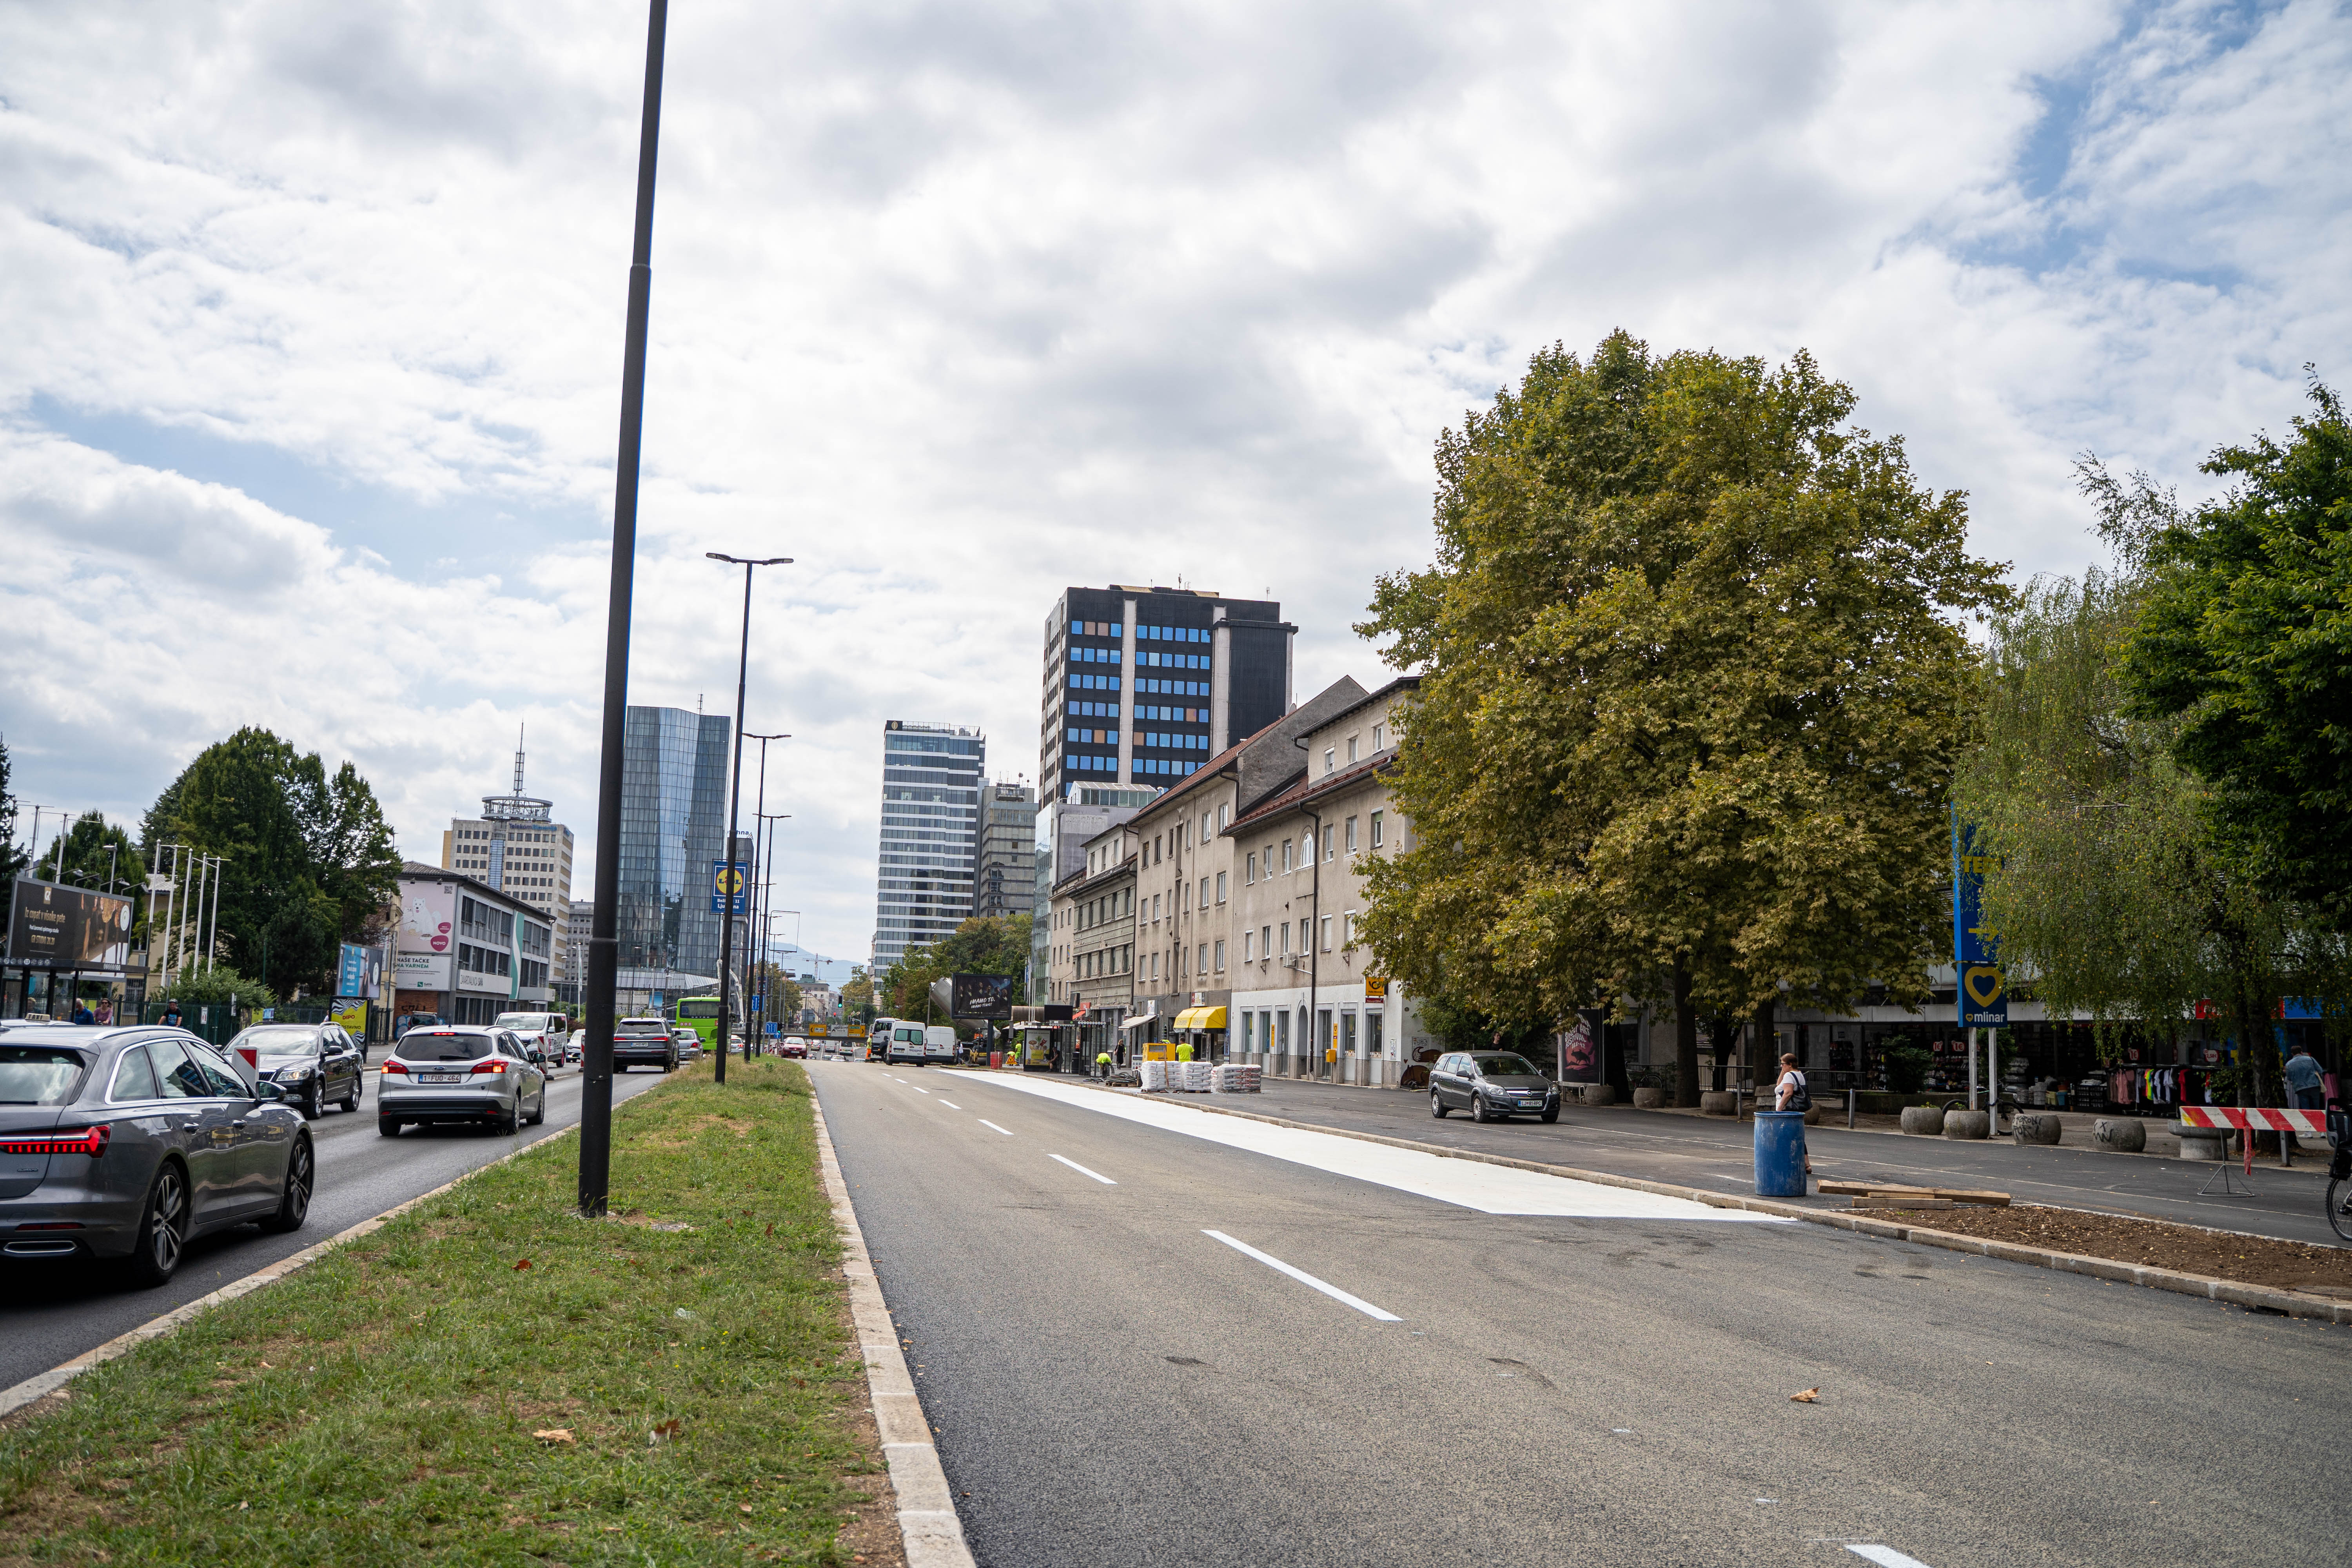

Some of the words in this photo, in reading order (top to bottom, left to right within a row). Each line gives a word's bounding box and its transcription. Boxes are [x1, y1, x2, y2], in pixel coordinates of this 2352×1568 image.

[1974, 1011, 2005, 1022] mlinar
[1580, 1023, 1590, 1036] ART
[1565, 1033, 1587, 1049] FESTIVAL
